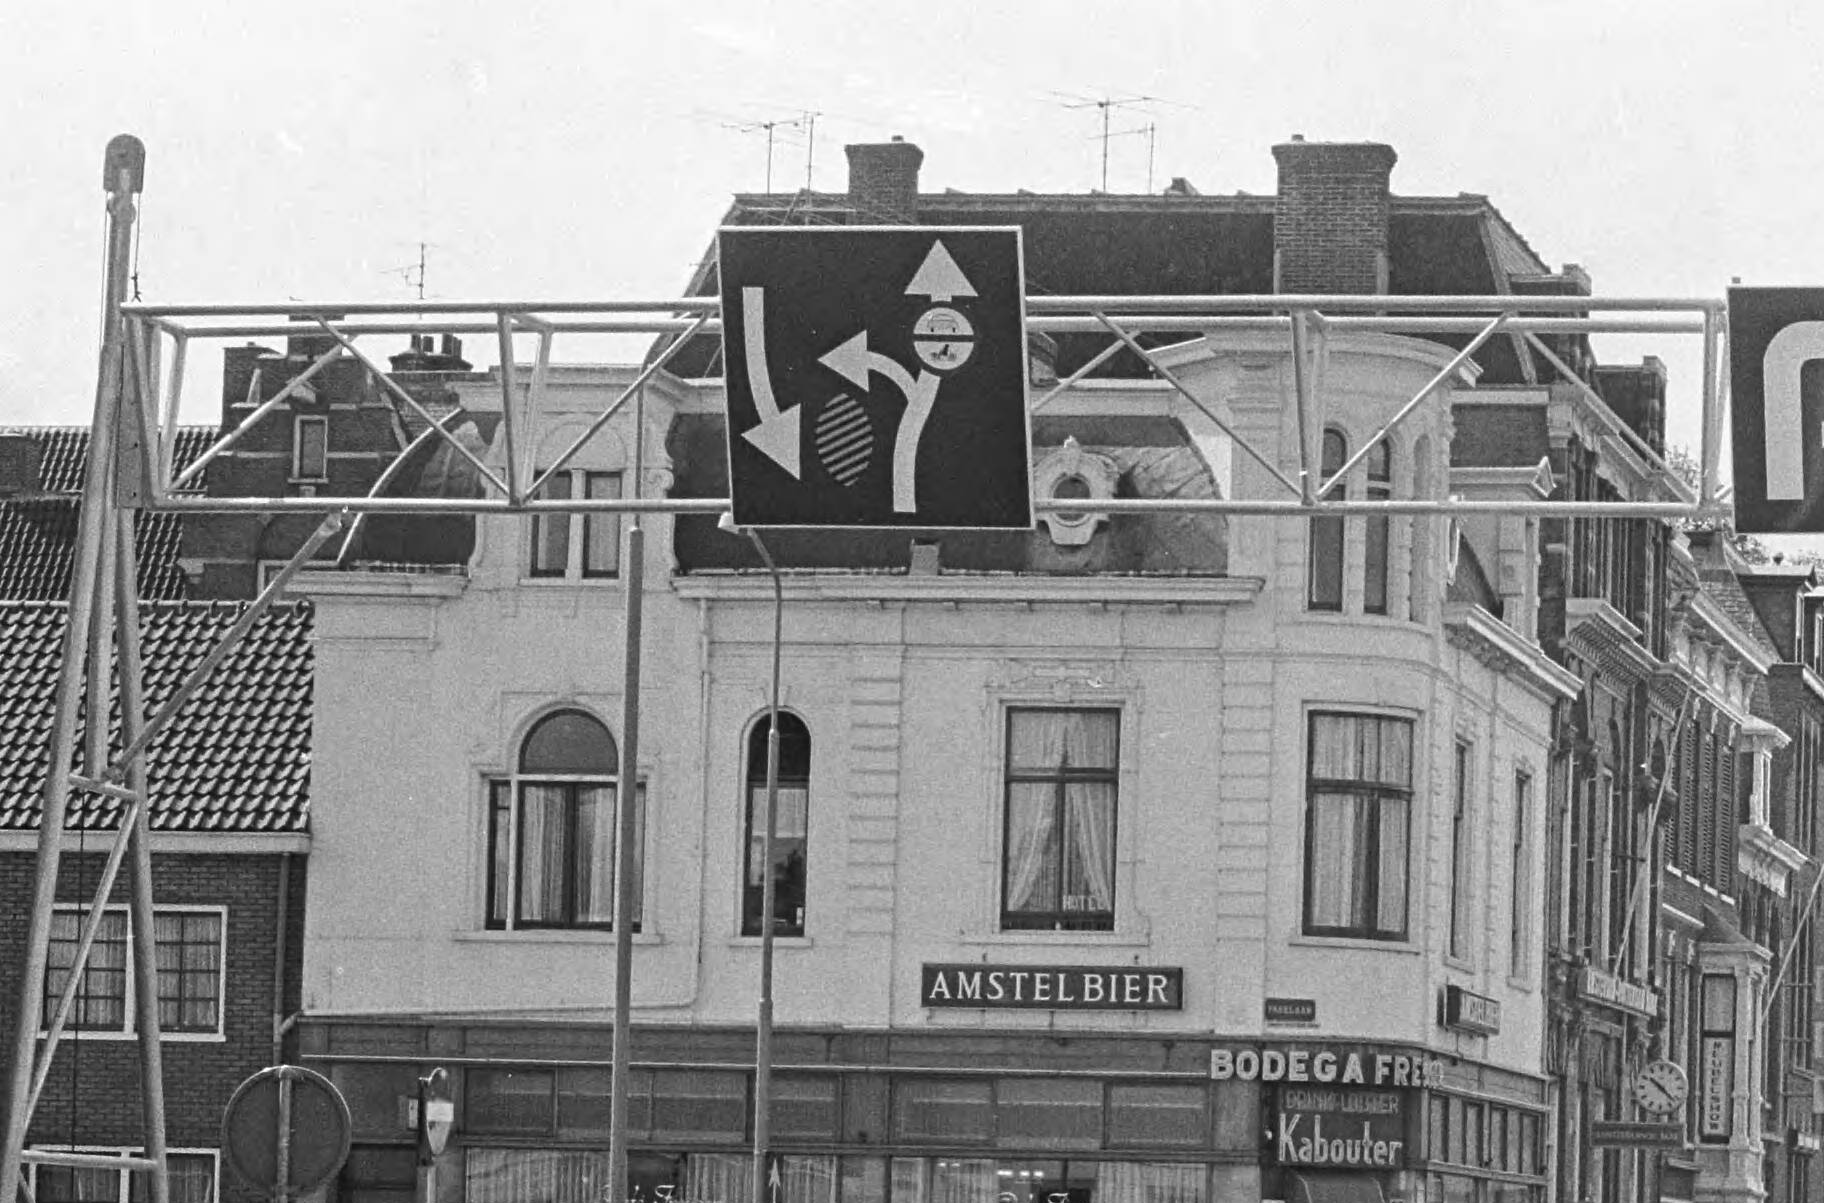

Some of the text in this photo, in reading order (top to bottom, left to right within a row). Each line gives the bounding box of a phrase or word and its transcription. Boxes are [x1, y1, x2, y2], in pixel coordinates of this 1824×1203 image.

[929, 970, 1168, 1003] AMSTEL BIER
[1210, 1049, 1365, 1084] BODEGA
[1278, 1113, 1403, 1165] Kabouter
